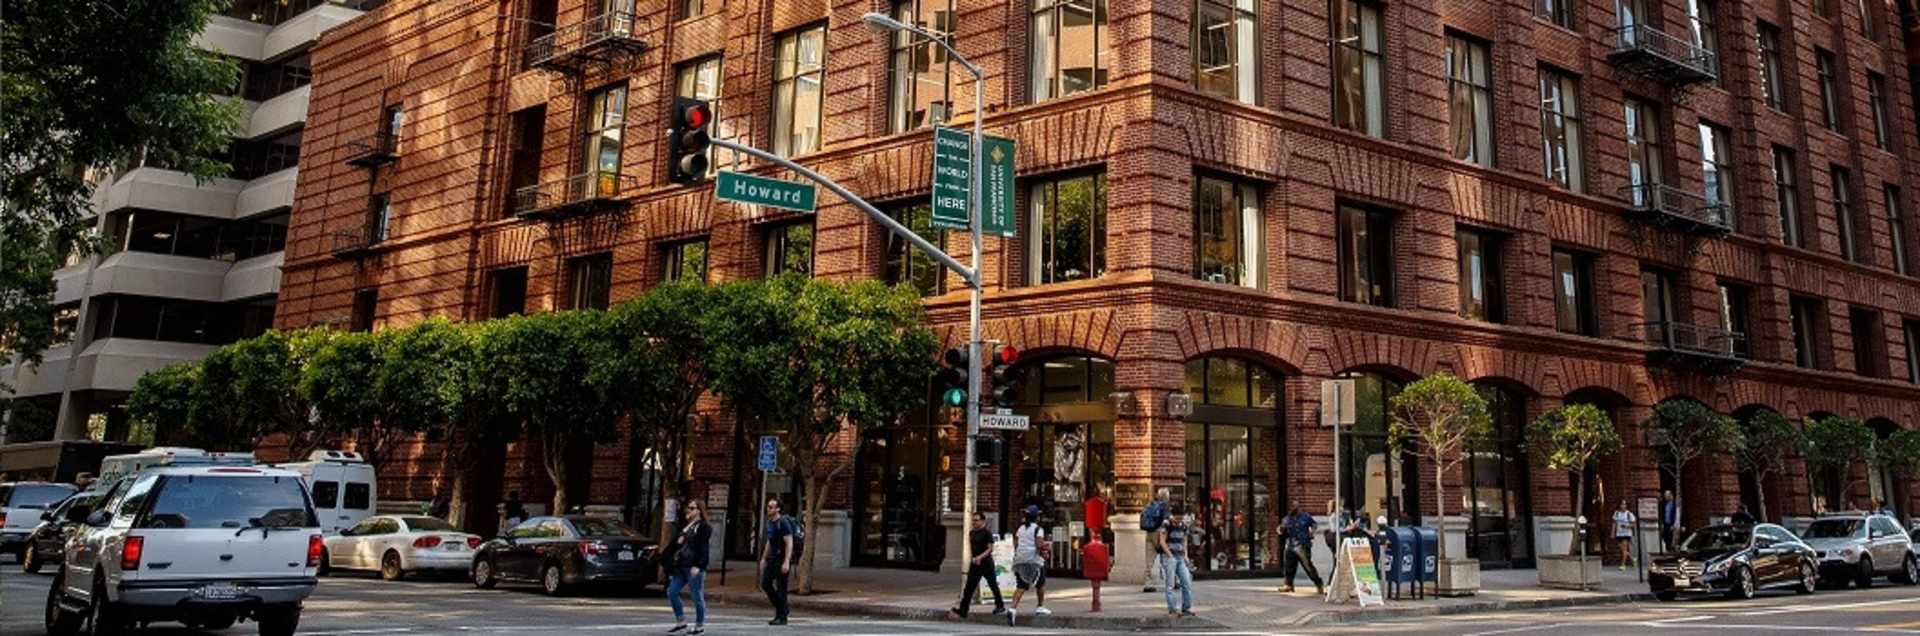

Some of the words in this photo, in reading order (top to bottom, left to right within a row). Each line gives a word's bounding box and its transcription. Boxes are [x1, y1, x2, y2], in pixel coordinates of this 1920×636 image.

[938, 166, 968, 178] WORLD
[734, 180, 801, 203] Howard
[937, 196, 966, 210] HERE
[983, 416, 1026, 427] HOWARD
